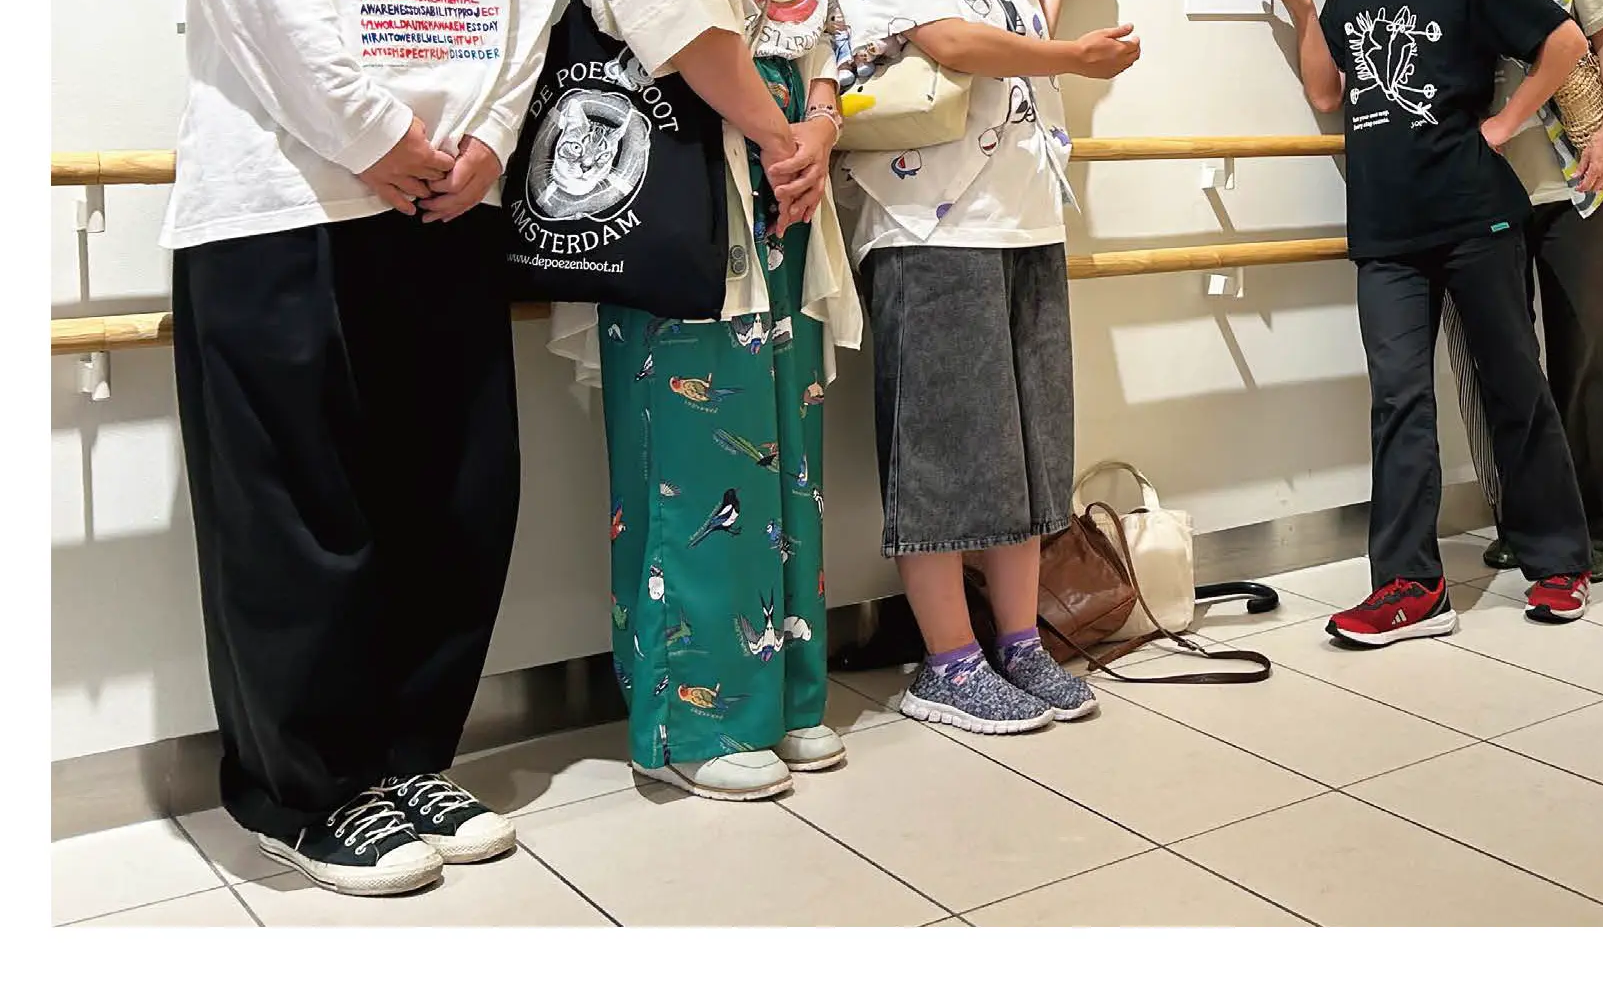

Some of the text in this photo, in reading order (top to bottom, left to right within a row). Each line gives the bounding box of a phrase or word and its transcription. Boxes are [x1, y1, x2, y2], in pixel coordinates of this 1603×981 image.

[530, 85, 554, 118] DE
[510, 198, 642, 255] AMSTERDAM
[506, 252, 624, 273] www.depoezenboot.nl
